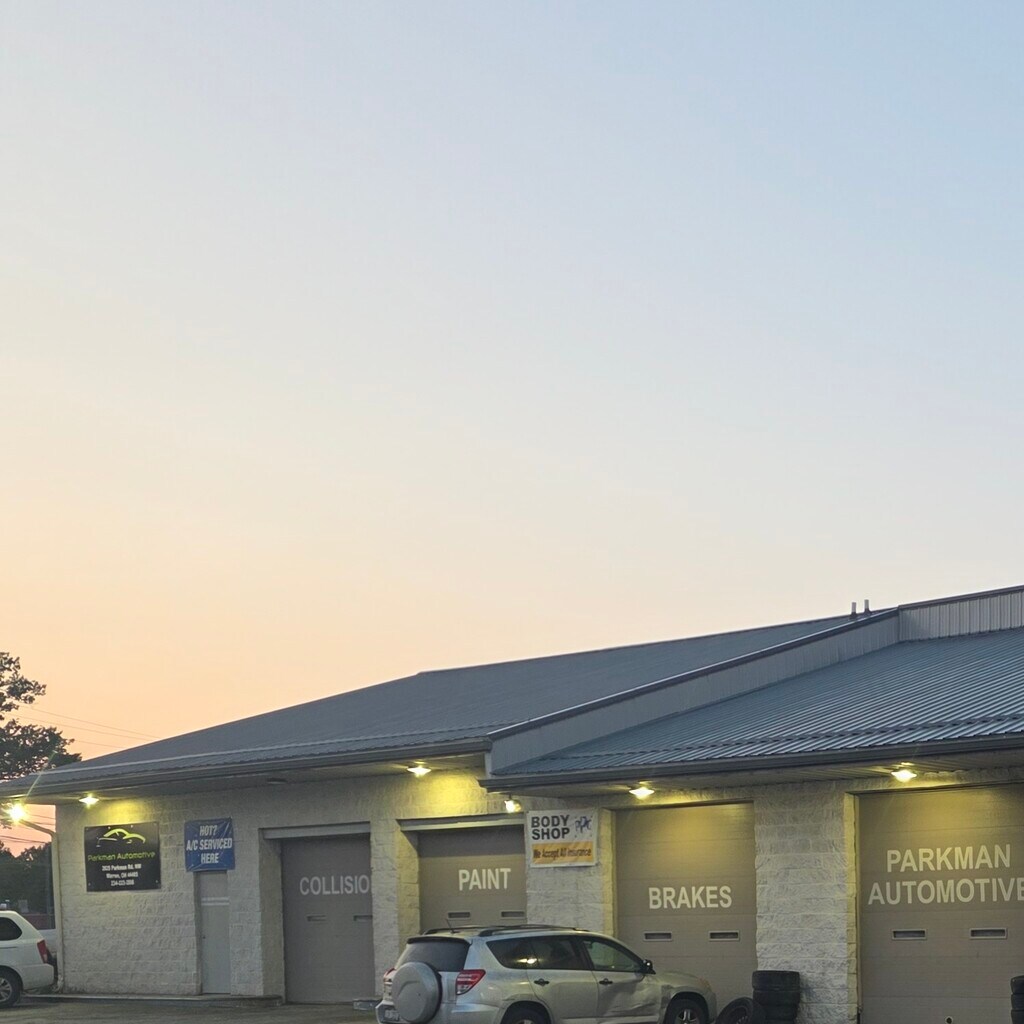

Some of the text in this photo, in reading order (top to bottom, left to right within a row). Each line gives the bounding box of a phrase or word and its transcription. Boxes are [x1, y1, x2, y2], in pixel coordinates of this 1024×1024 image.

[531, 814, 570, 828] BODY
[199, 824, 218, 836] HOT?
[531, 827, 570, 840] SHOP
[186, 837, 233, 851] A/C SERVICED
[117, 851, 156, 860] Automotive
[200, 852, 219, 864] HERE
[886, 843, 1012, 873] PARKMAN
[299, 874, 371, 896] COLLISIO
[458, 868, 512, 891] PAINT
[648, 884, 733, 910] BRAKES
